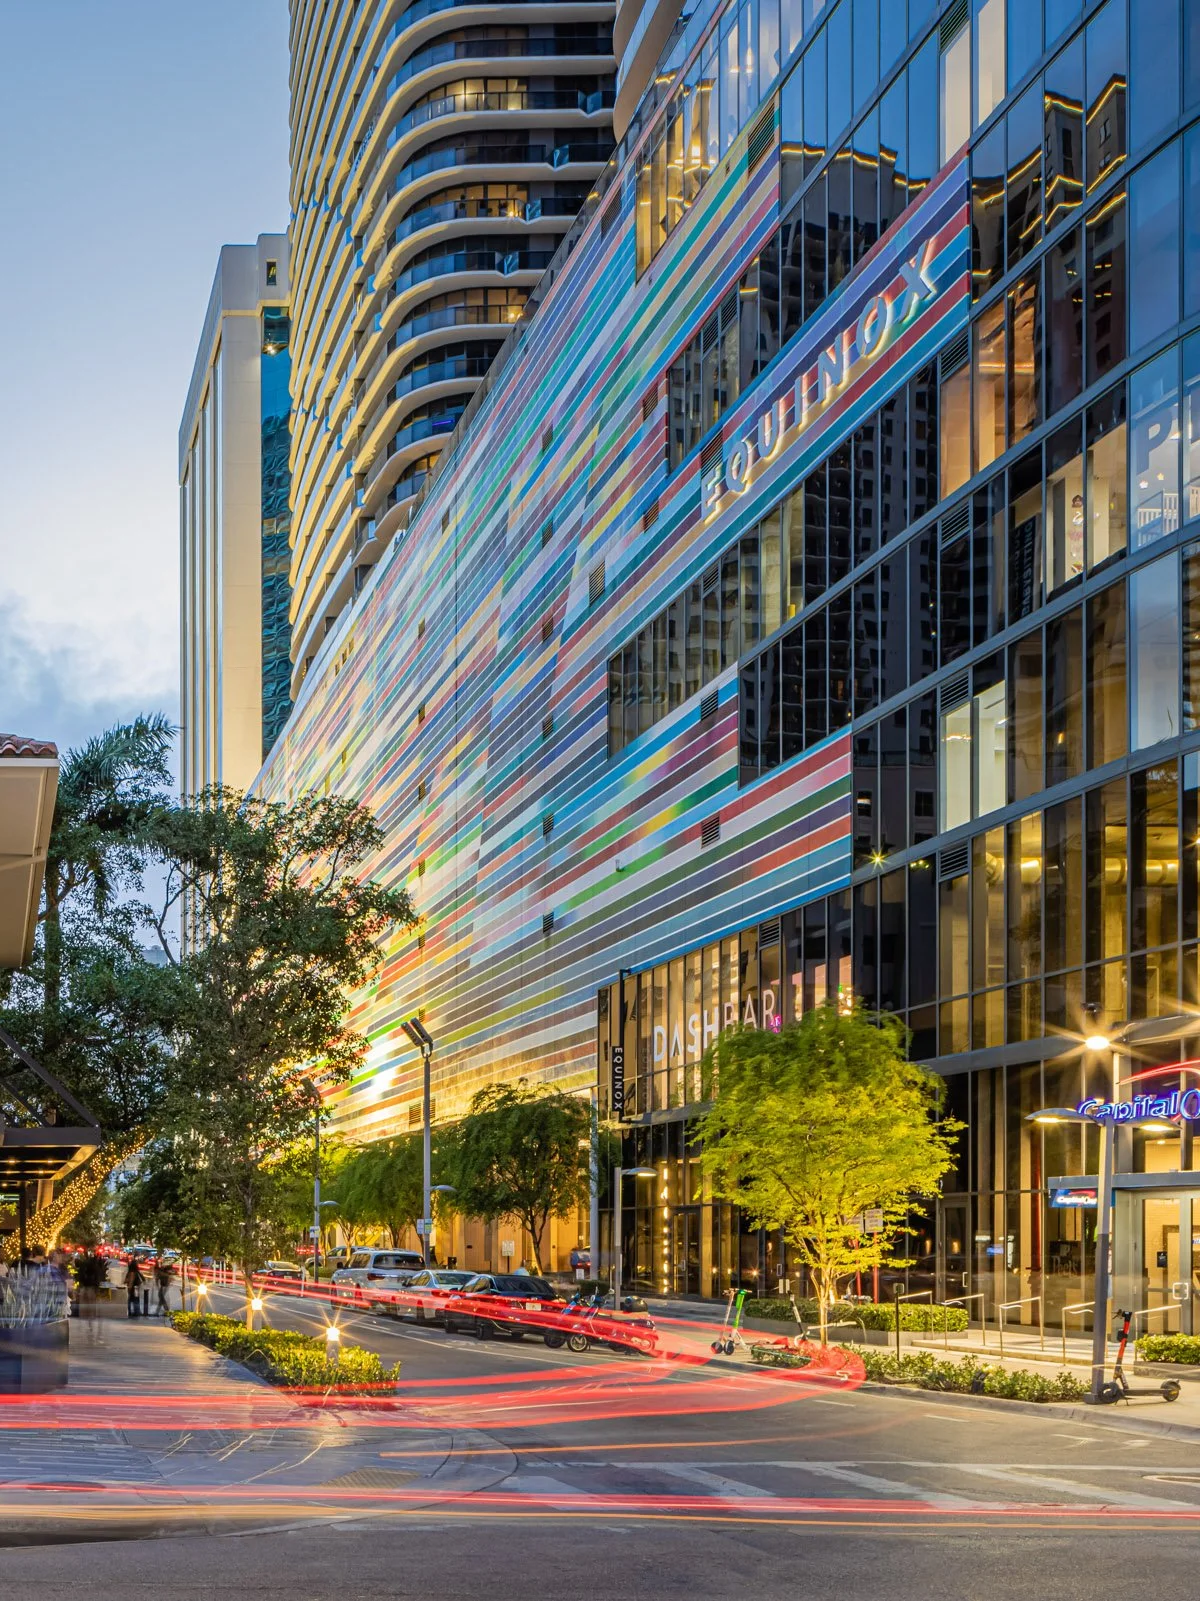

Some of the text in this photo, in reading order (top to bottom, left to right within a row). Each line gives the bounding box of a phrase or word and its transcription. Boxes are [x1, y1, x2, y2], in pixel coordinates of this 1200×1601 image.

[701, 239, 935, 521] EQUINOX
[1021, 520, 1033, 618] BABYSITTING
[613, 1047, 623, 1110] EQUINOX
